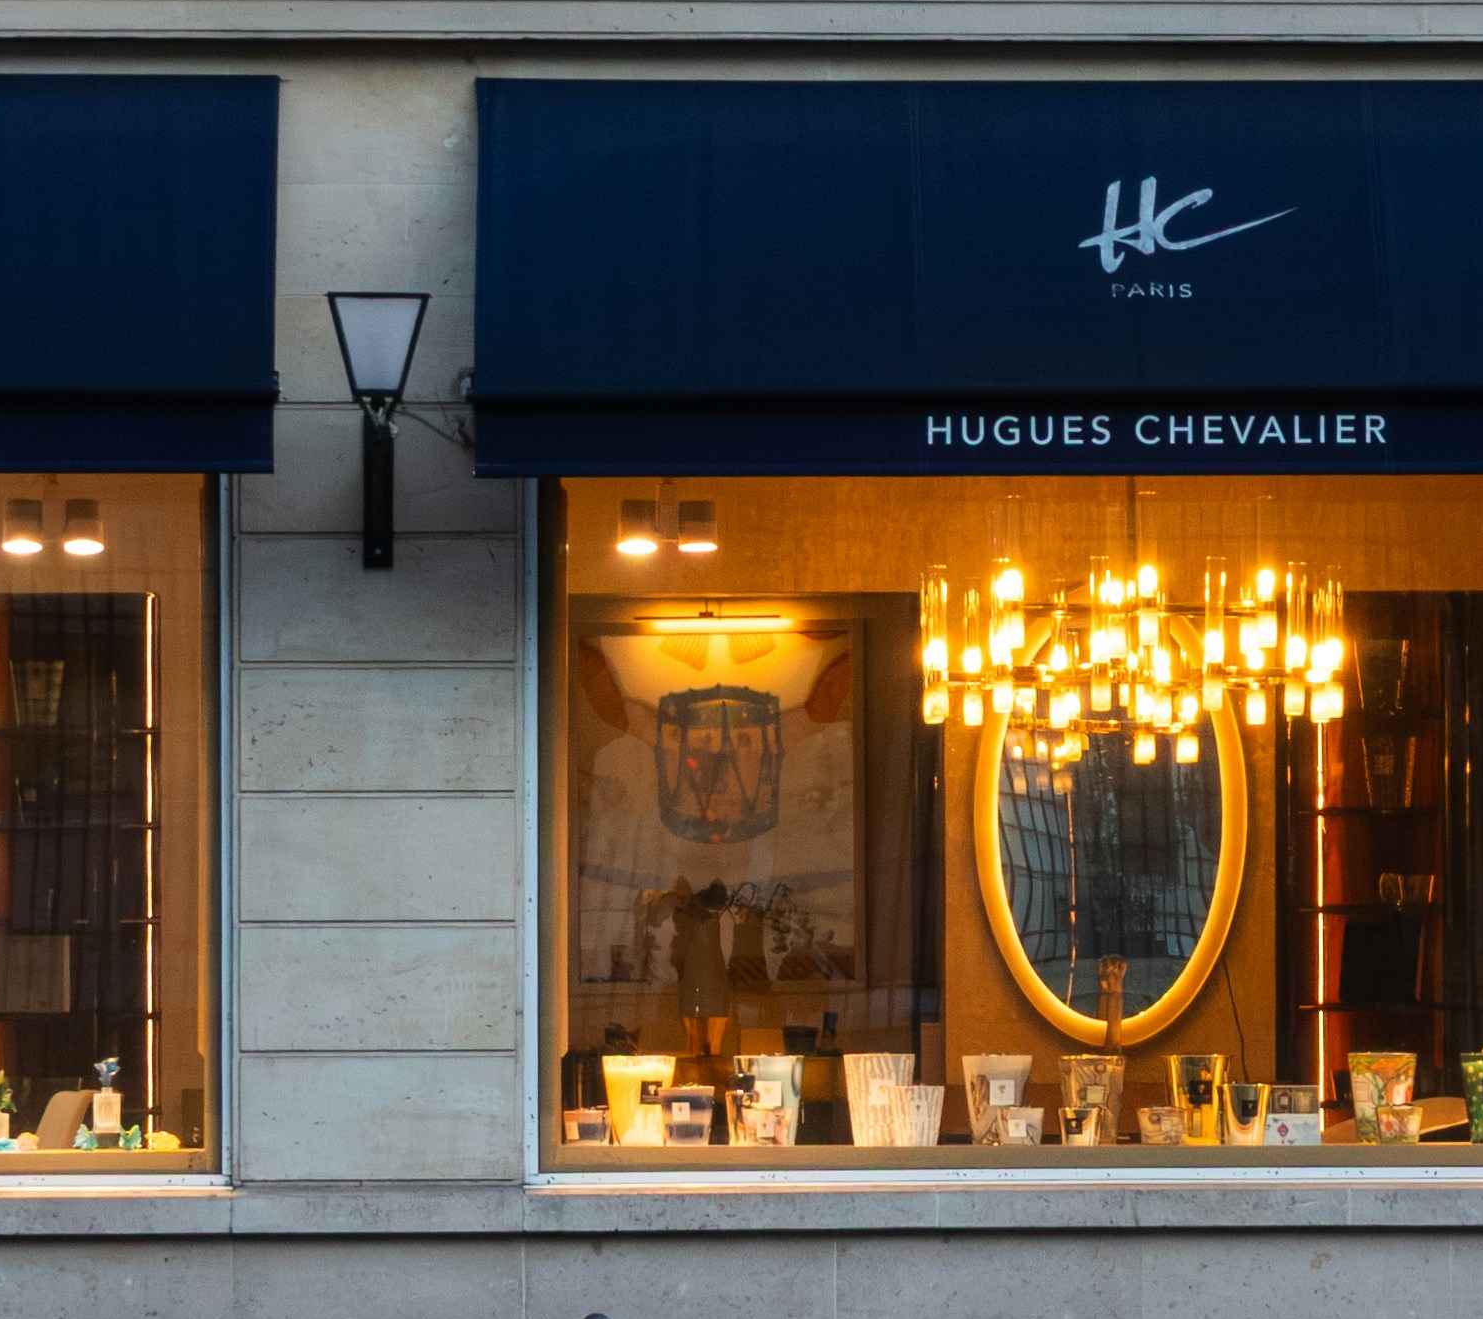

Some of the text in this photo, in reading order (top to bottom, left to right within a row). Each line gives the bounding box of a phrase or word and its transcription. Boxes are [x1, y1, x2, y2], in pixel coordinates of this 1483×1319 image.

[1078, 176, 1298, 273] HC
[1112, 282, 1193, 298] PARIS
[927, 414, 1386, 445] HUGUES CHEVALIER
